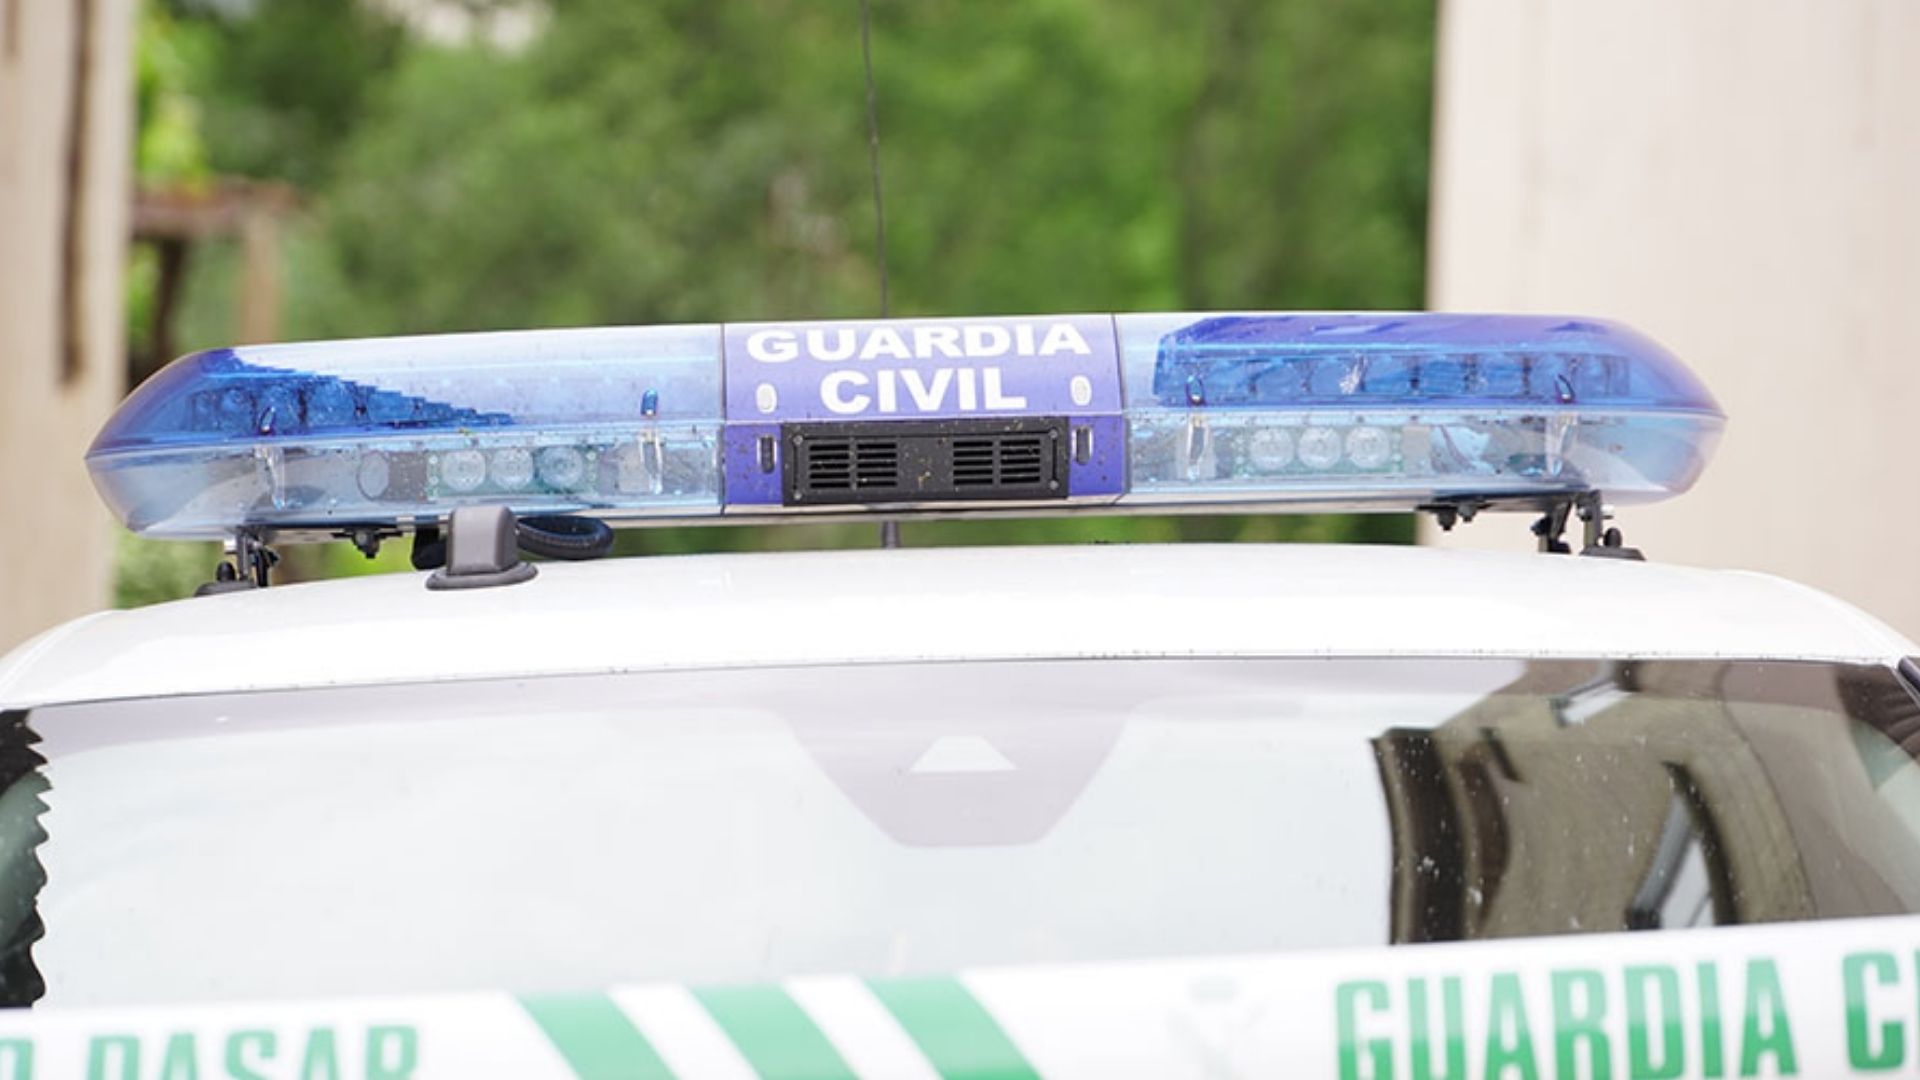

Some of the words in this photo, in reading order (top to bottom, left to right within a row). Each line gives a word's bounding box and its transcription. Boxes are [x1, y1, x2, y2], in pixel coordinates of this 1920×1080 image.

[747, 323, 1091, 363] GUARDIA
[819, 367, 1027, 414] CIVIL
[1335, 958, 1799, 1080] GUARDIA
[1841, 948, 1920, 1072] C
